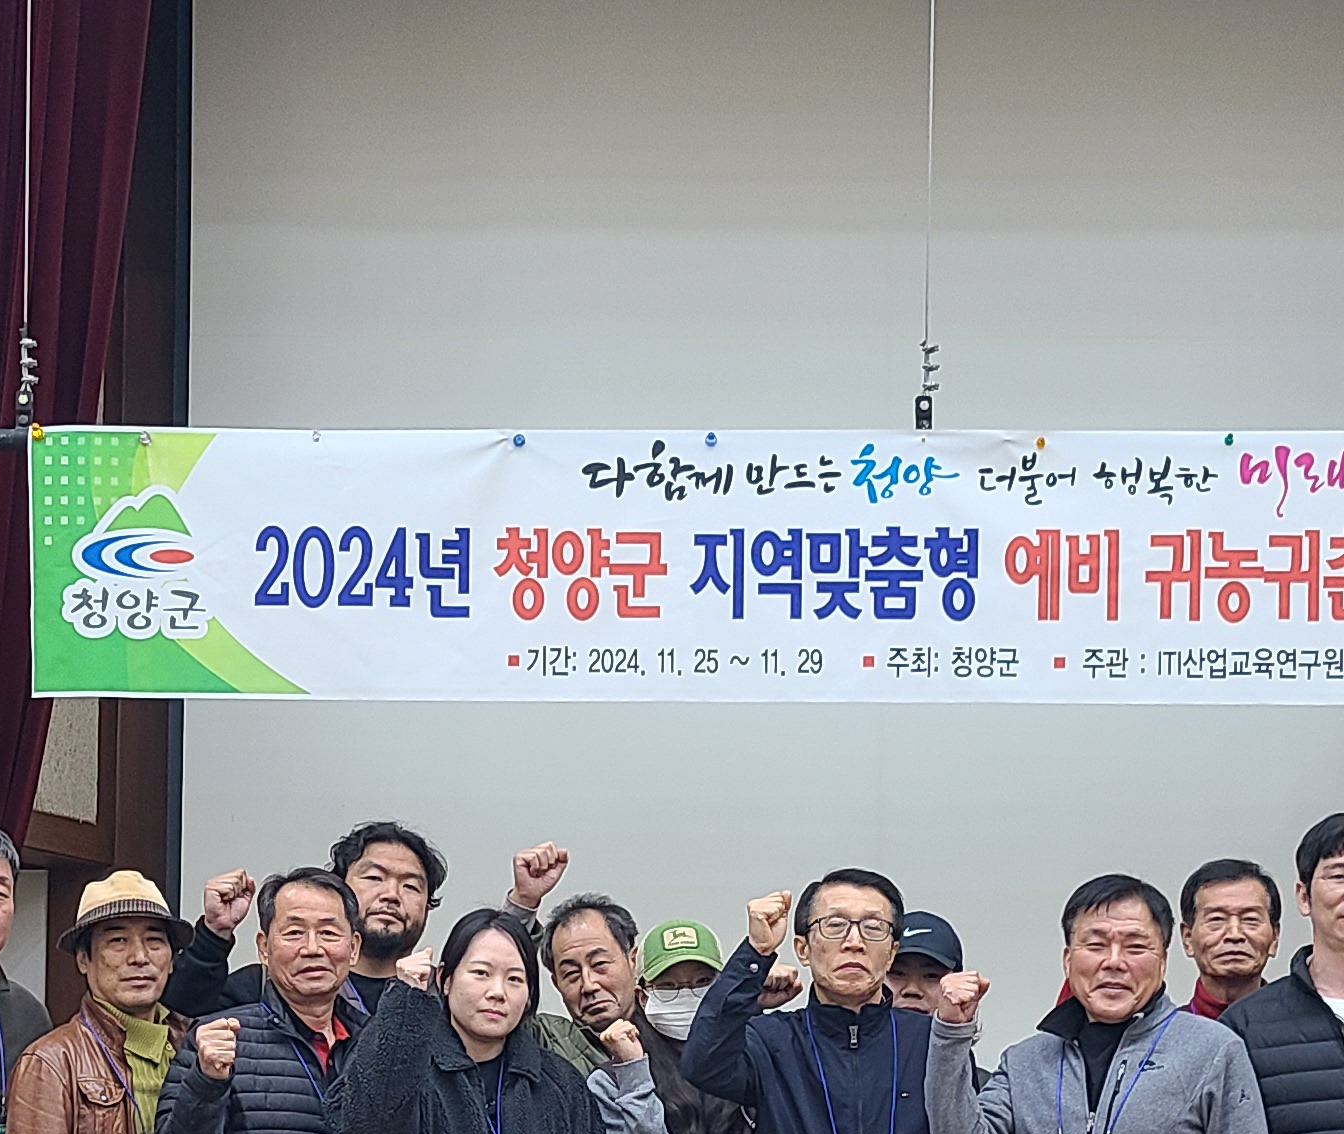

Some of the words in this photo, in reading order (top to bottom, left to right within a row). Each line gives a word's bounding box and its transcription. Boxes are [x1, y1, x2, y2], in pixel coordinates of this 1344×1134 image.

[581, 439, 735, 501] 다함께
[745, 453, 843, 496] 만드는
[850, 443, 961, 504] 청양
[977, 451, 1077, 506] 더불어
[1092, 456, 1219, 506] 행복한
[255, 525, 471, 619] 2024년
[493, 526, 668, 622] 청양군
[689, 526, 980, 622] 지역맞춤형
[1004, 528, 1120, 622] 예비
[70, 586, 207, 630] 청양군
[526, 645, 577, 677] 기간:
[588, 648, 646, 677] 2024.
[657, 647, 682, 677] 11.
[693, 648, 719, 674] 25
[760, 648, 786, 677] 11.
[797, 648, 823, 675] 29
[886, 646, 939, 679] 주최:
[951, 646, 1020, 678] 청양군
[1082, 647, 1129, 679] 주관
[1157, 647, 1344, 681] ITI산업교육연구원
